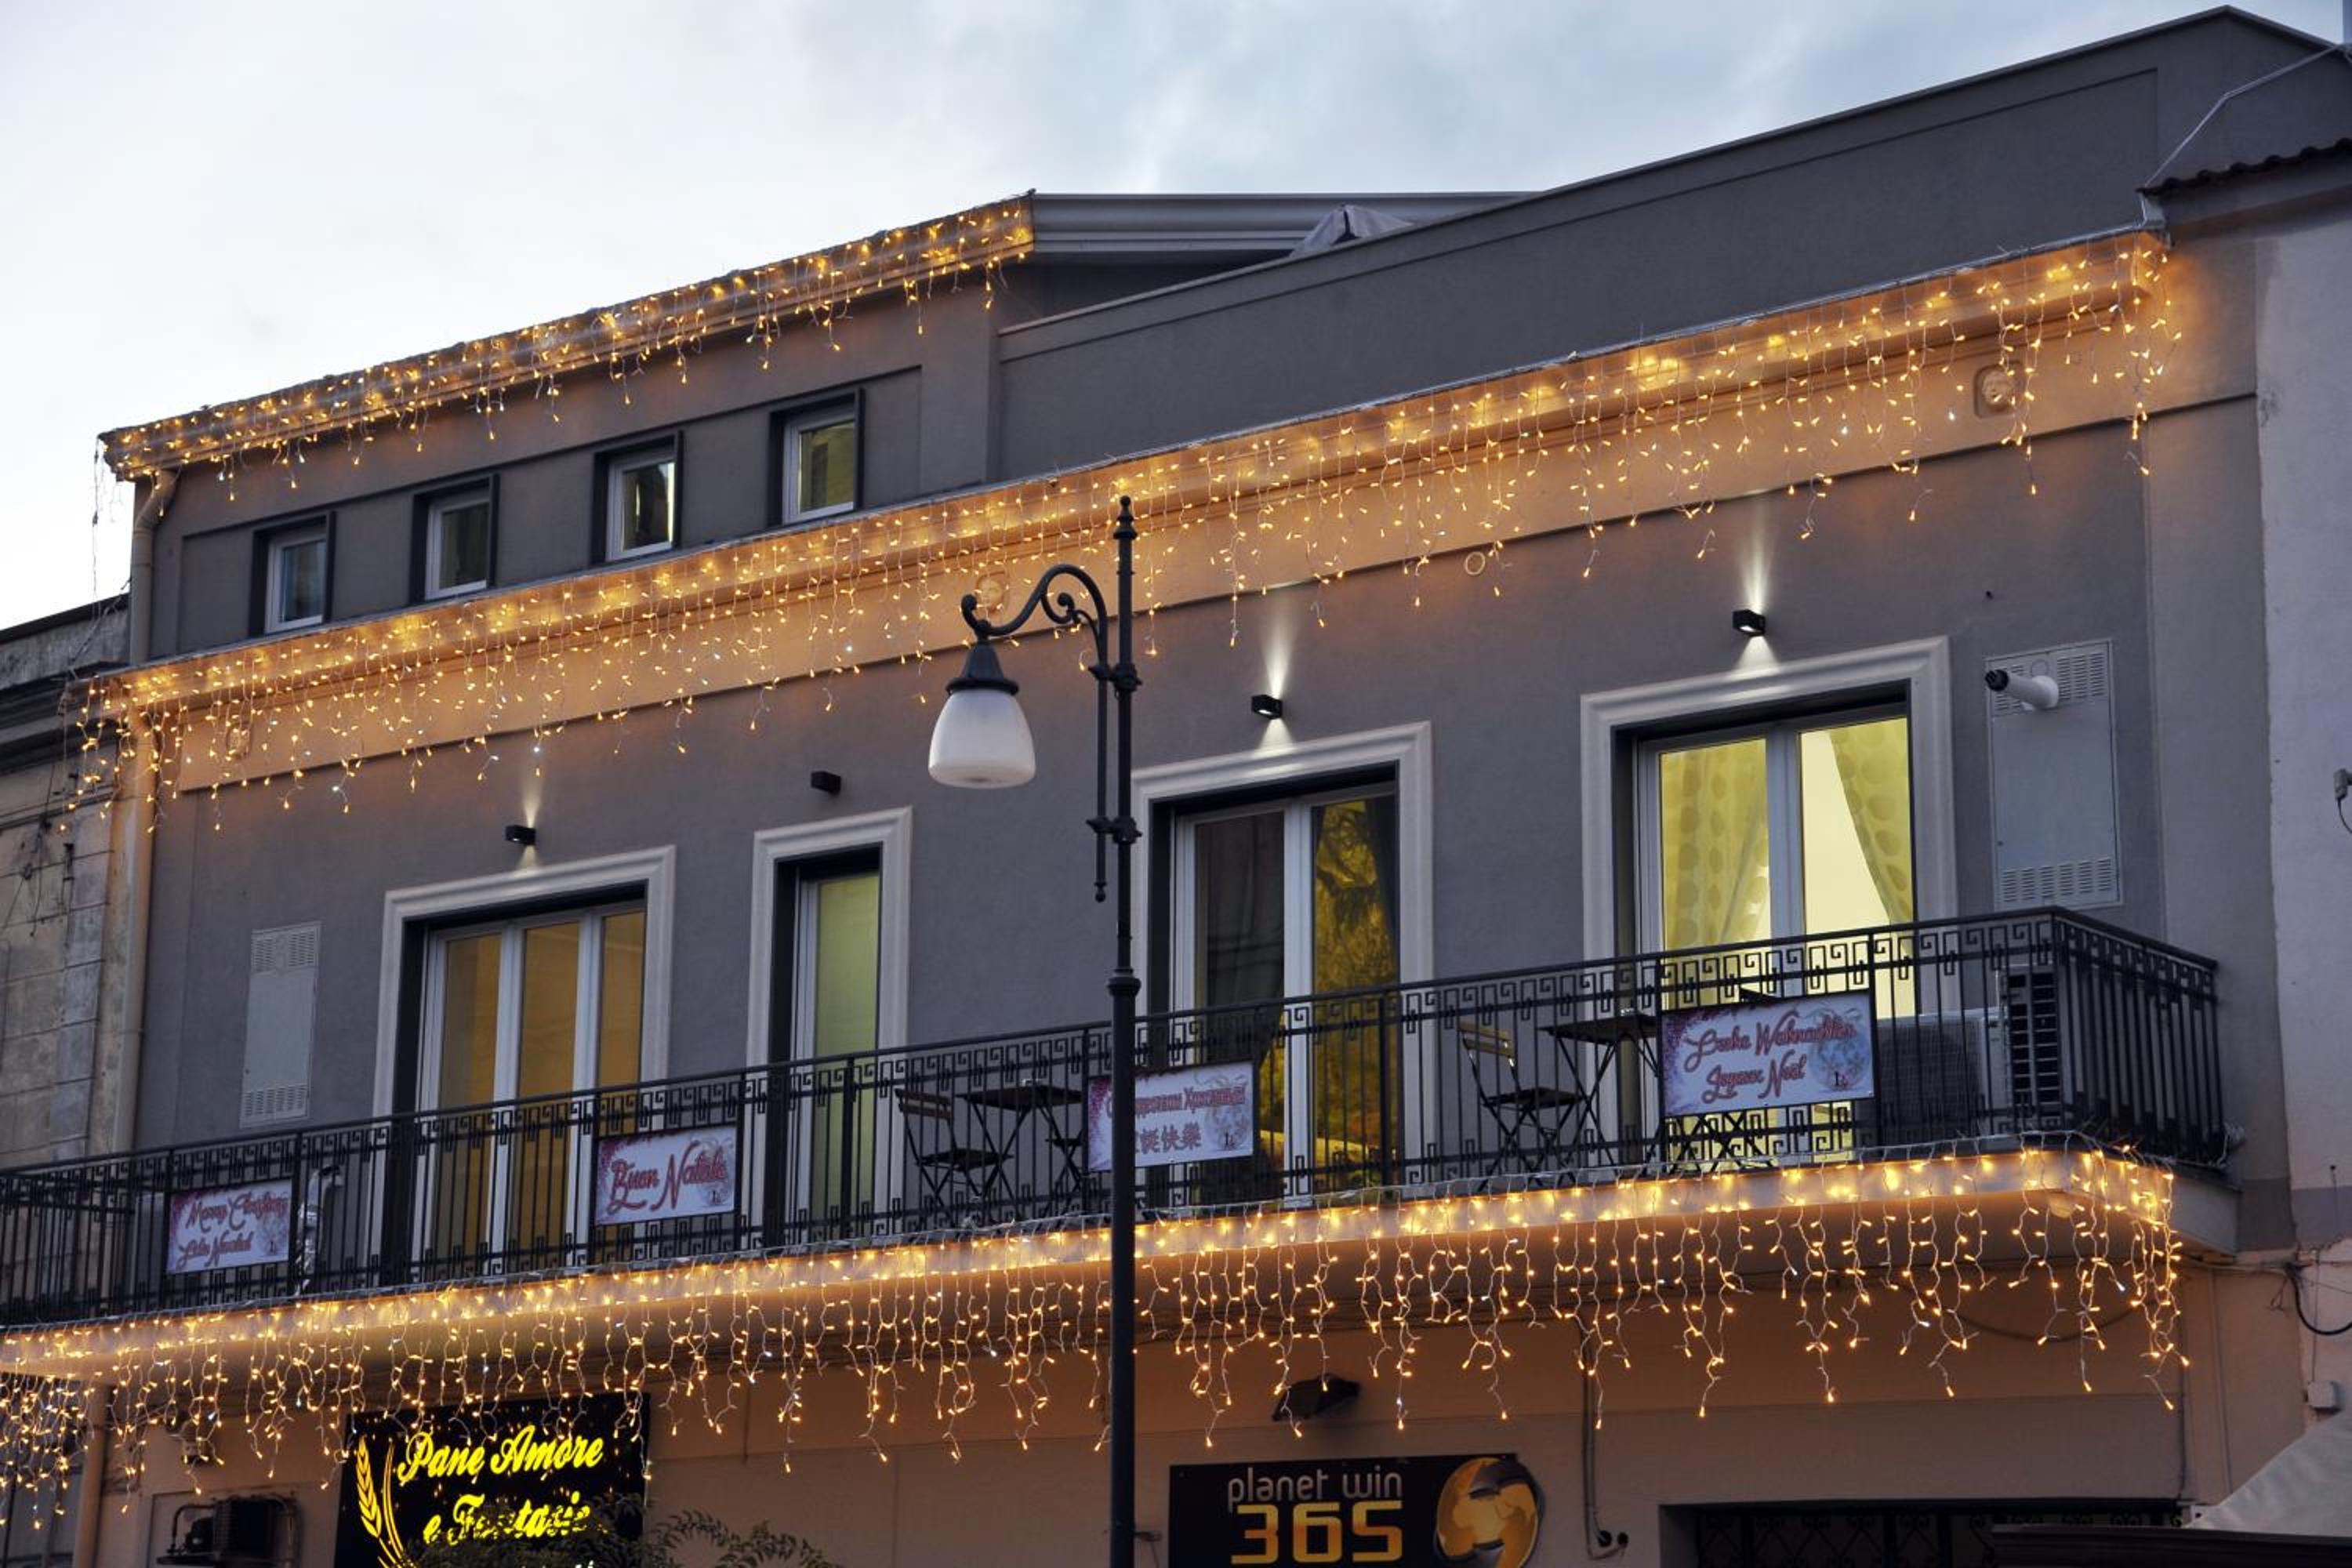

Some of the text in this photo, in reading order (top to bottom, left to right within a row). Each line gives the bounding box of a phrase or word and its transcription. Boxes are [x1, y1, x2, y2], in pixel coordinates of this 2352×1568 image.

[1701, 1064, 1764, 1104] Joyeux
[652, 1140, 728, 1210] Natale
[185, 1190, 289, 1233] Merry Christmas
[397, 1425, 604, 1483] Pane Amore
[1228, 1465, 1403, 1513] planet win
[1231, 1500, 1404, 1565] 365
